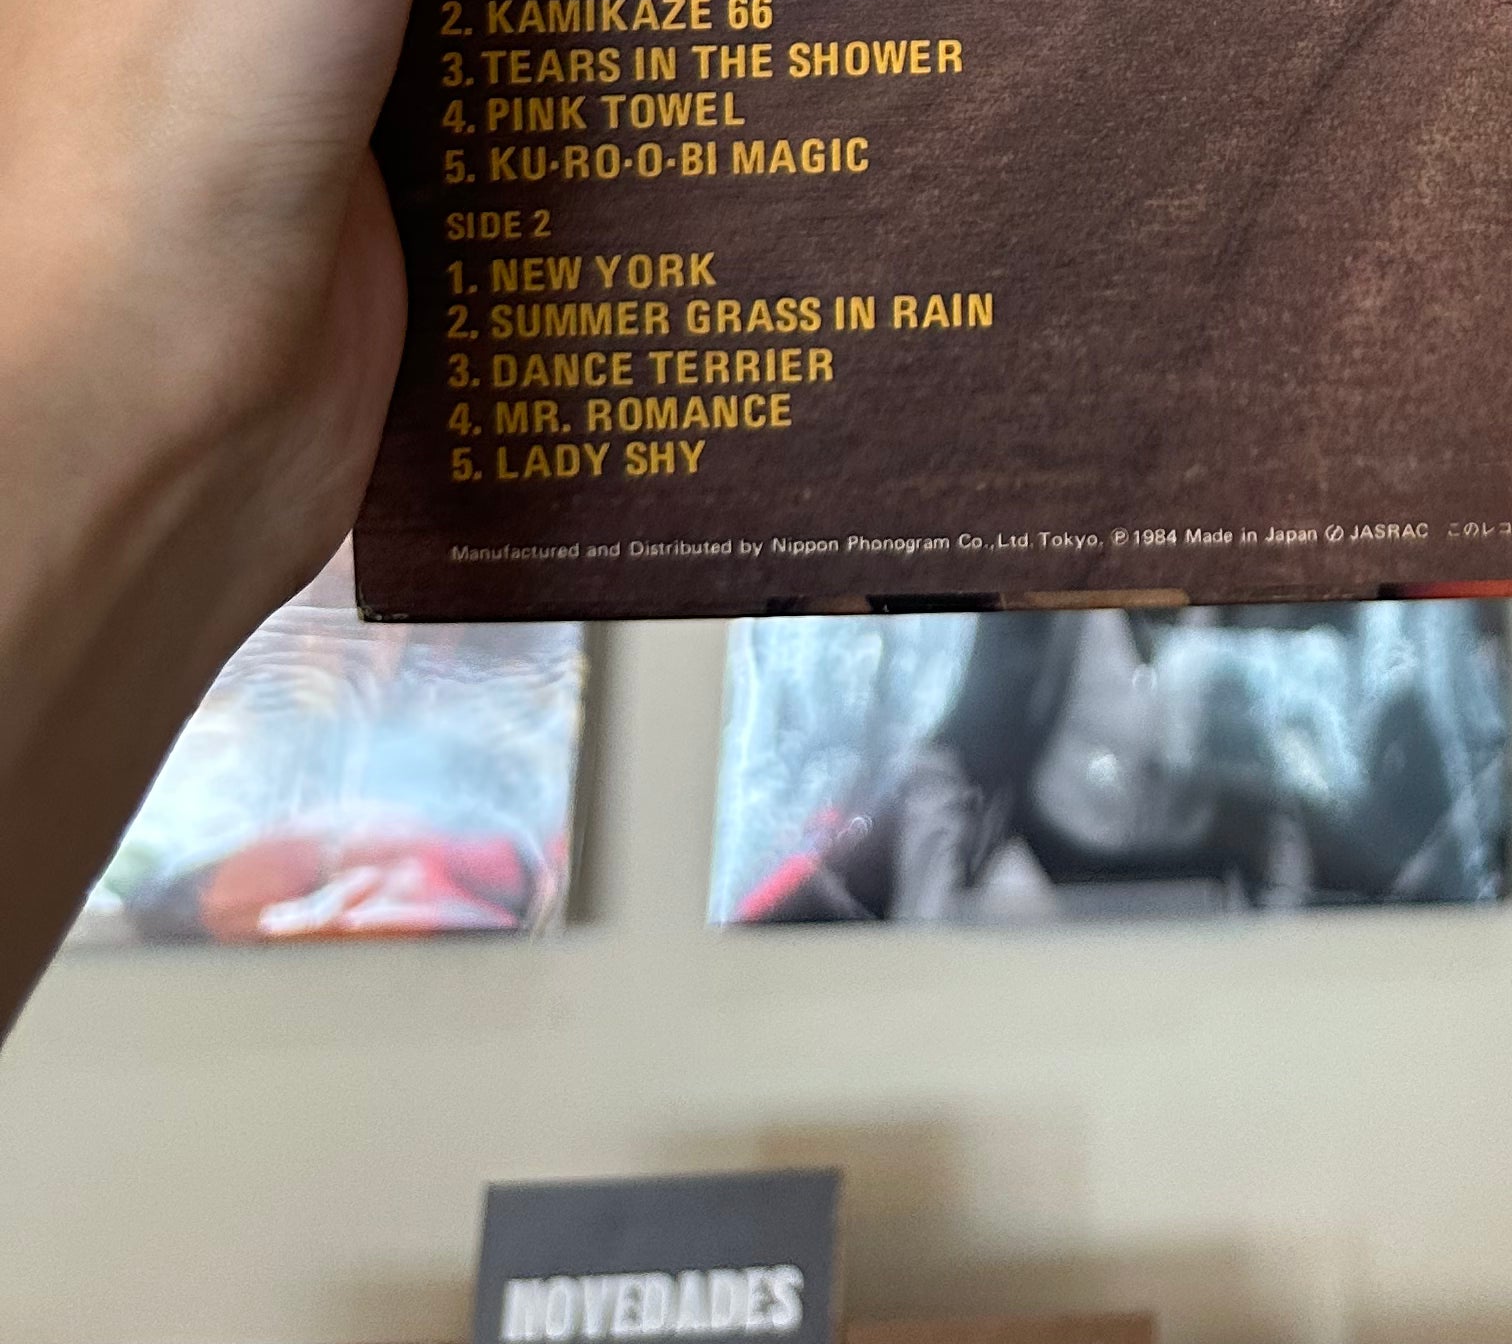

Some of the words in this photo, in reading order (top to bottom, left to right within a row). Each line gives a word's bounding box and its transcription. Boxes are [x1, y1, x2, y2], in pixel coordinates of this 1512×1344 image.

[440, 3, 473, 36] 2.
[441, 51, 475, 87] 3.
[481, 47, 621, 85] TEARS
[635, 46, 677, 81] IN
[692, 43, 774, 80] THE
[788, 38, 964, 78] SHOWER
[442, 100, 476, 134] 4.
[488, 95, 588, 133] PINK
[601, 91, 746, 130] TOWEL
[444, 149, 476, 184] 5.
[732, 136, 870, 175] MAGIC
[446, 212, 522, 240] SIDE
[534, 210, 552, 238] 2
[446, 261, 478, 295] 1.
[492, 256, 582, 293] NEW
[596, 252, 716, 289] YORK
[447, 305, 479, 339] 2.
[491, 301, 671, 338] SUMMER
[686, 297, 822, 335] GRASS
[835, 295, 875, 331] IN
[893, 293, 994, 330] RAIN
[448, 354, 481, 389] 3.
[493, 351, 634, 388] DANCE
[648, 347, 834, 386] TERRIER
[448, 402, 482, 436] 4.
[496, 398, 571, 434] MR.
[587, 393, 793, 431] ROMANCE
[452, 447, 483, 481] 5.
[496, 442, 610, 480] LADY
[625, 439, 706, 477] SHY
[450, 543, 580, 562] Manufactured
[586, 541, 620, 557] and
[630, 539, 732, 557] Distributed
[740, 538, 763, 557] by
[772, 536, 839, 555] Nippon
[847, 534, 950, 554] Phonogram
[1185, 527, 1233, 545] Made
[1241, 526, 1258, 543] in
[1265, 526, 1318, 545] Japan
[1350, 523, 1428, 541] JASRAC
[505, 1265, 805, 1344] NOVEDADES
